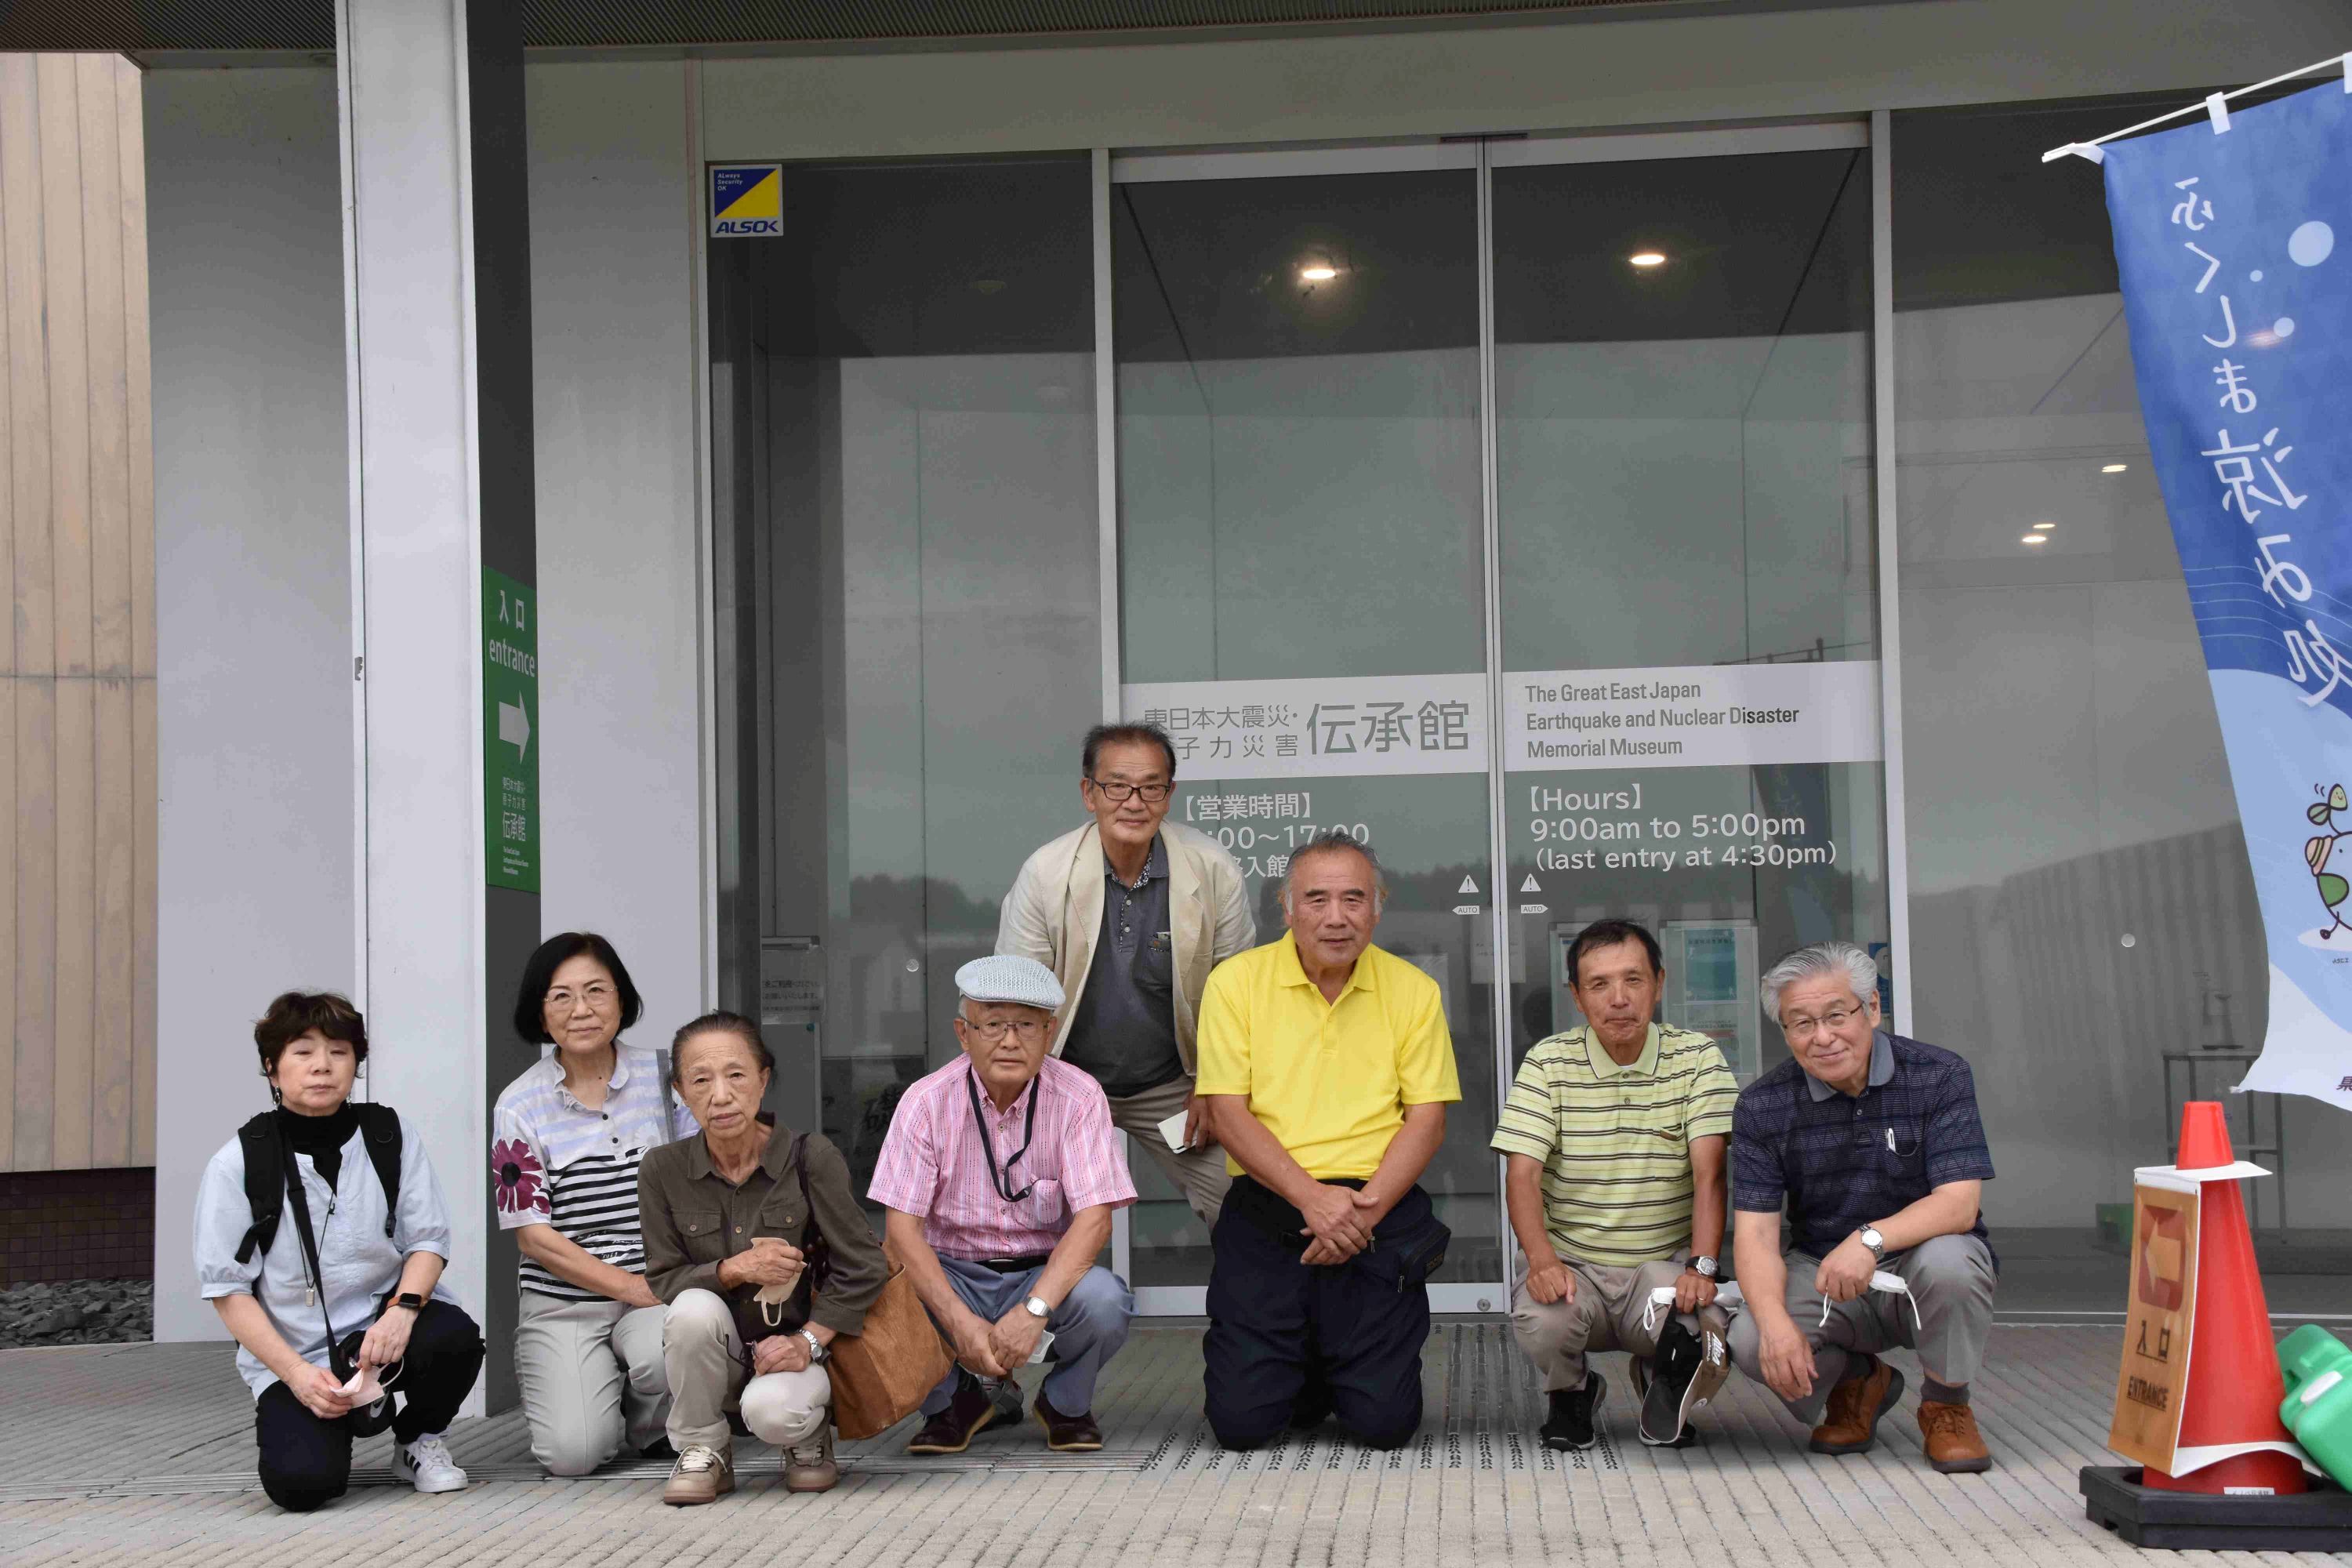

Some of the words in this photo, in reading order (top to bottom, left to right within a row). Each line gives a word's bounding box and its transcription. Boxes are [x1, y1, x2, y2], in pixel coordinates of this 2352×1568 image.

[715, 220, 779, 234] ALSOK
[499, 590, 524, 631] 入口
[489, 637, 535, 677] entrance
[1525, 685, 1556, 702] The
[1561, 684, 1607, 702] Great
[1610, 682, 1646, 699] East
[1649, 681, 1700, 702] Japan
[1307, 700, 1469, 755] 伝承館
[1526, 711, 1621, 732] Earthquake
[1625, 710, 1655, 728] and
[1660, 707, 1726, 726] Nuclear
[1730, 706, 1799, 724] Disaster
[1527, 739, 1606, 758] Memorial
[1610, 738, 1682, 756] Museum
[1186, 792, 1310, 821] 【営業時間】
[1530, 817, 1640, 842] 9:00am
[1650, 817, 1680, 838] to
[1692, 813, 1805, 840] 5:00pm
[1536, 847, 1595, 871] (last
[1605, 848, 1676, 871] entry
[1686, 846, 1711, 866] at
[1721, 840, 1837, 869] 4:30pm)
[2136, 1319, 2170, 1358] 入口
[2127, 1376, 2169, 1409] ENTRANCE
